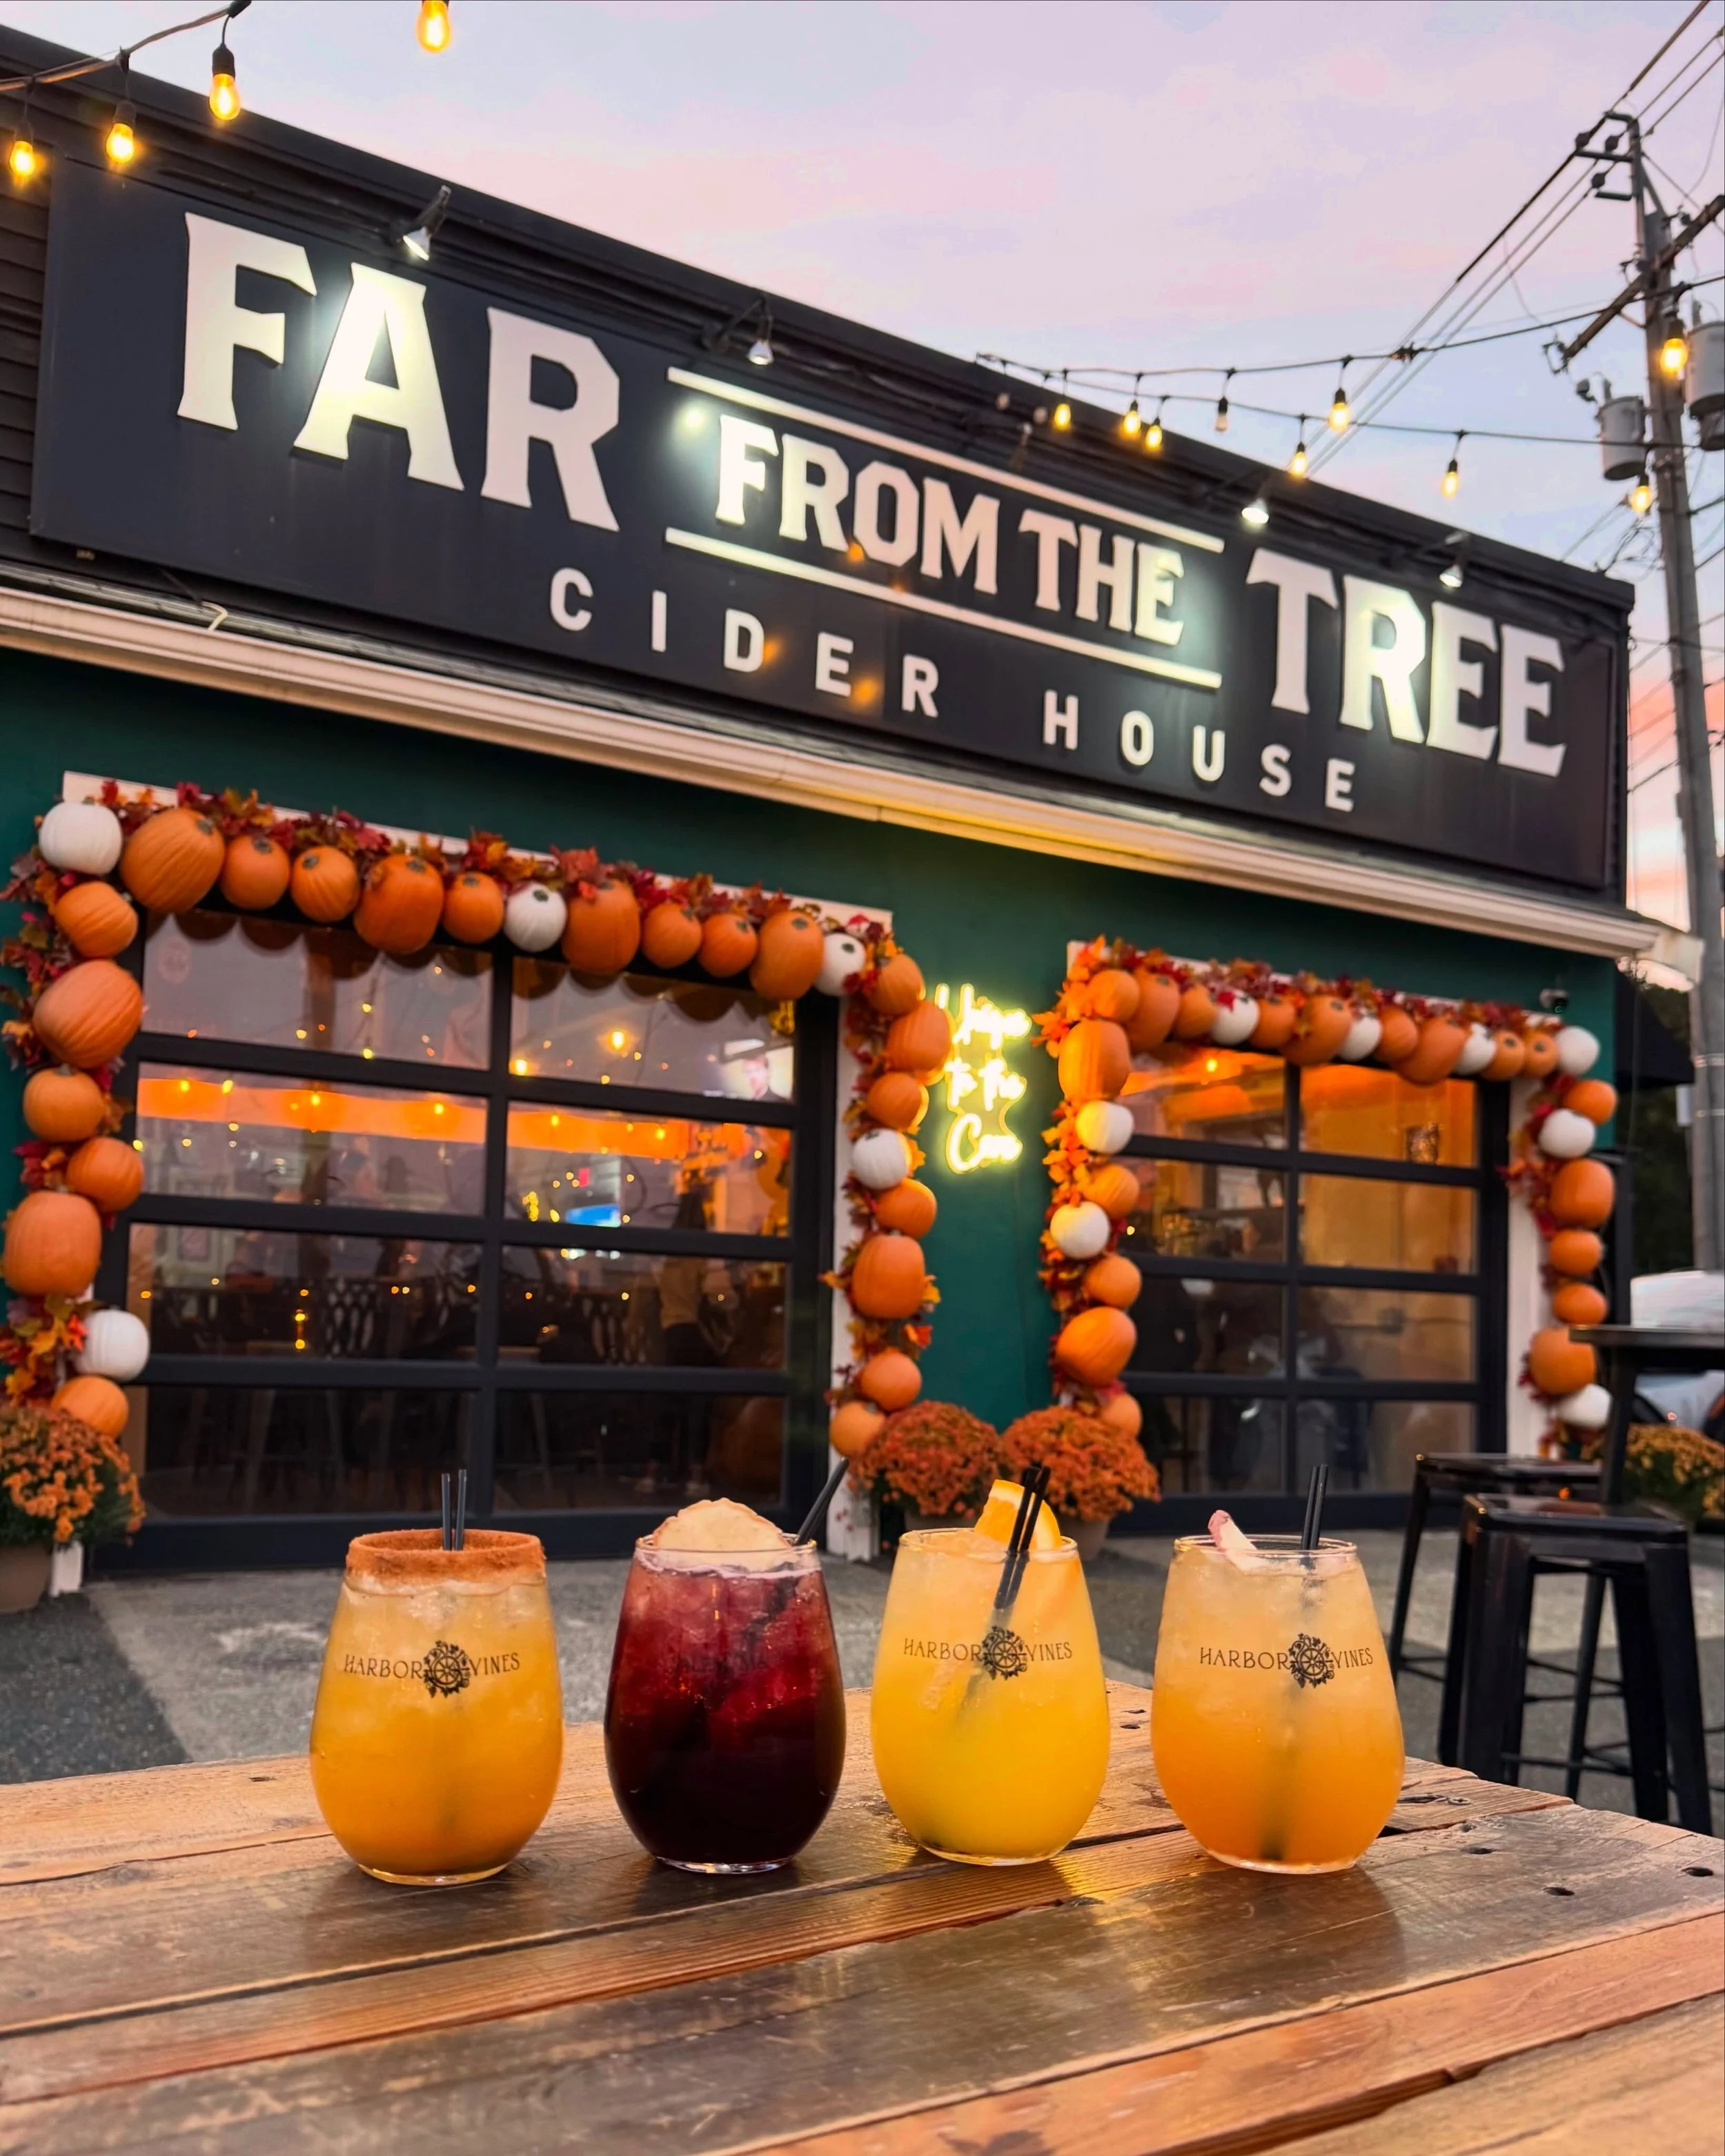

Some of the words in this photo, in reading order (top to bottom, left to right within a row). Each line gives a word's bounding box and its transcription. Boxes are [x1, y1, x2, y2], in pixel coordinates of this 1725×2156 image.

[177, 211, 620, 532] FAR
[715, 414, 1000, 595] FROM
[1018, 508, 1185, 646] THE
[1246, 548, 1566, 778] TREE
[550, 567, 940, 718] CIDER
[1043, 689, 1355, 813] HOUSE
[904, 1638, 983, 1661] HARBOR
[1025, 1641, 1072, 1661] VINES
[1199, 1647, 1290, 1670] HARBOR
[1331, 1648, 1373, 1668] VINES
[344, 1654, 423, 1679] HARBOR
[469, 1652, 520, 1677] VINES
